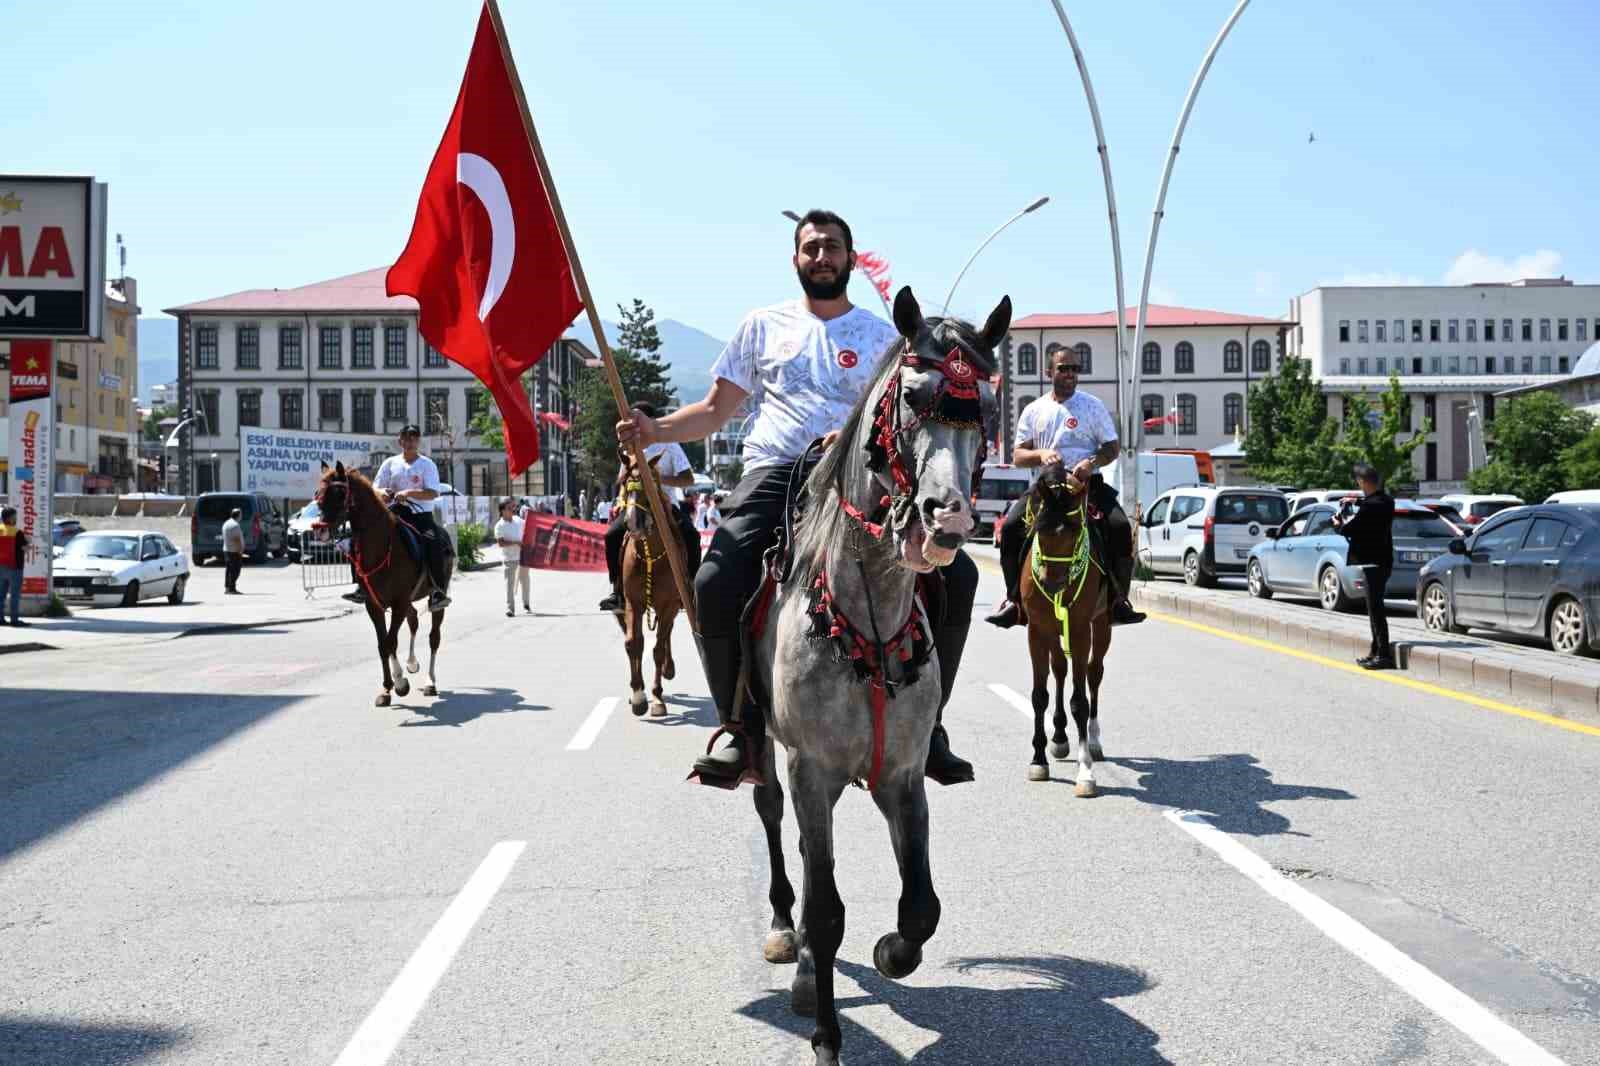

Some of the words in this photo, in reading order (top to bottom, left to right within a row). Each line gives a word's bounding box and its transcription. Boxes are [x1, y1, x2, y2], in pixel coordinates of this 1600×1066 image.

[12, 375, 47, 385] TEMA
[247, 435, 273, 446] ESKİ
[276, 436, 331, 449] BELEDİYE
[247, 447, 291, 460] ASLINA
[294, 449, 333, 462] UYGUN
[247, 459, 310, 473] YAPILIYOR
